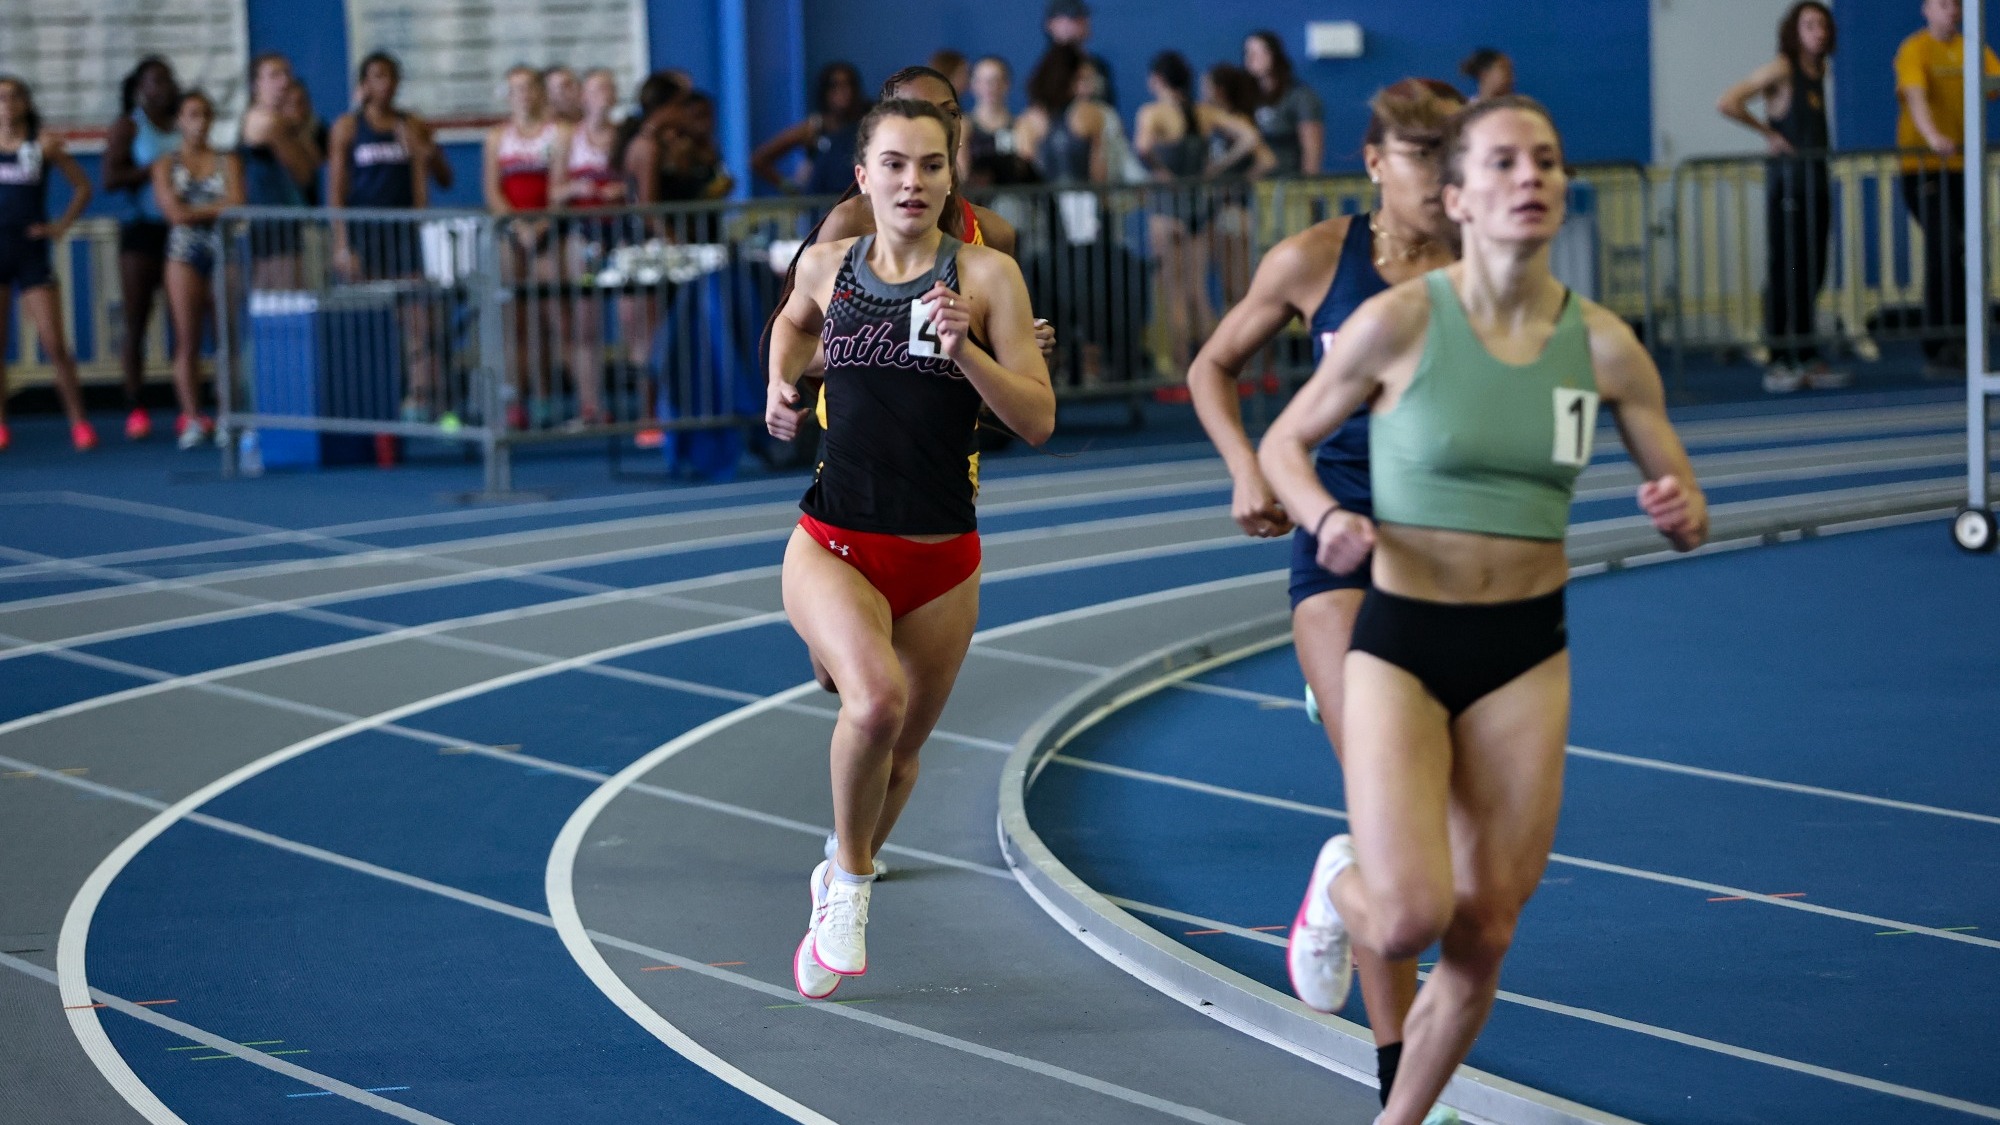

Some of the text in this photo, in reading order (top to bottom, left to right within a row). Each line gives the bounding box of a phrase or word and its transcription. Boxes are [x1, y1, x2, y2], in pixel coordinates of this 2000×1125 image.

[823, 318, 966, 379] Catho
[918, 318, 942, 354] 4
[1568, 396, 1583, 460] 1
